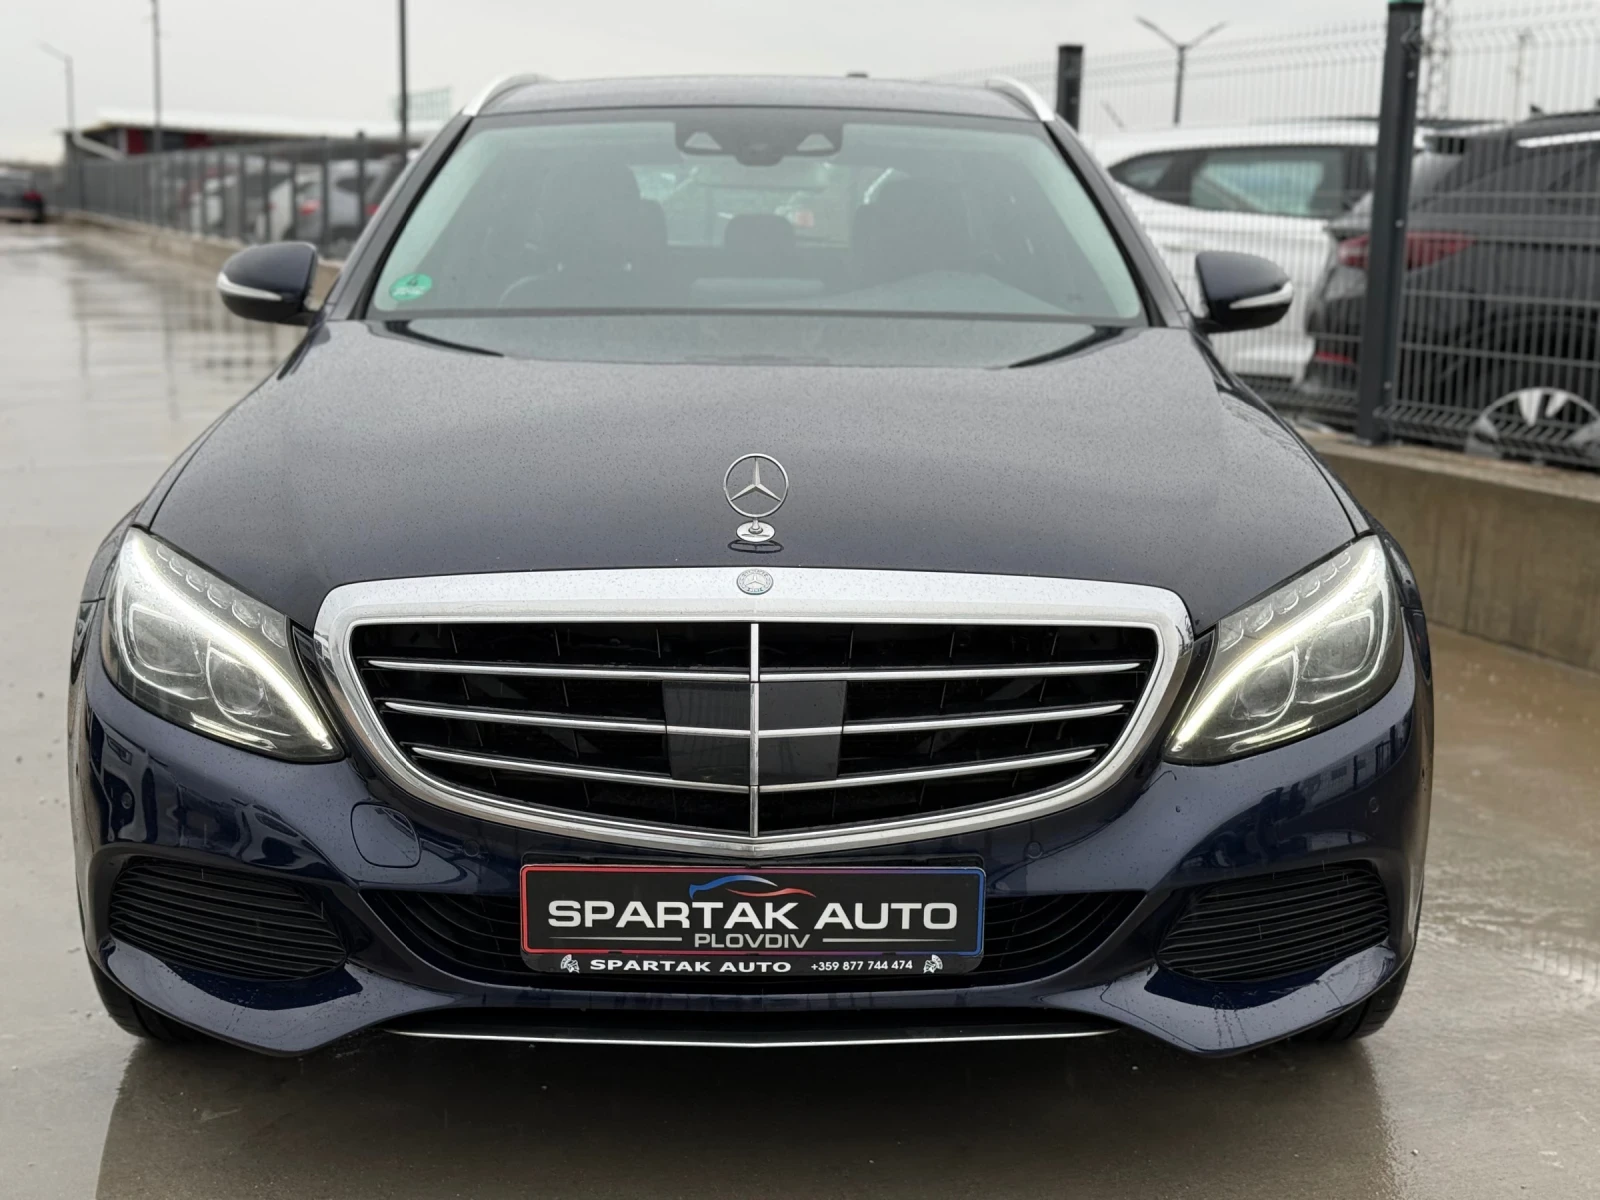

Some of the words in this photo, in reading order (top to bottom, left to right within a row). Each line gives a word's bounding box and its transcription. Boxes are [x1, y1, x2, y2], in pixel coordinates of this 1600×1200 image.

[548, 900, 799, 930] SPARTAK
[813, 902, 958, 930] AUTO
[694, 933, 811, 949] PLOVDIV
[590, 959, 711, 973] SPARTAK
[719, 961, 792, 973] AUTO
[811, 961, 840, 971] +359
[842, 960, 863, 971] 877
[867, 960, 889, 971] 744
[891, 959, 913, 970] 474
